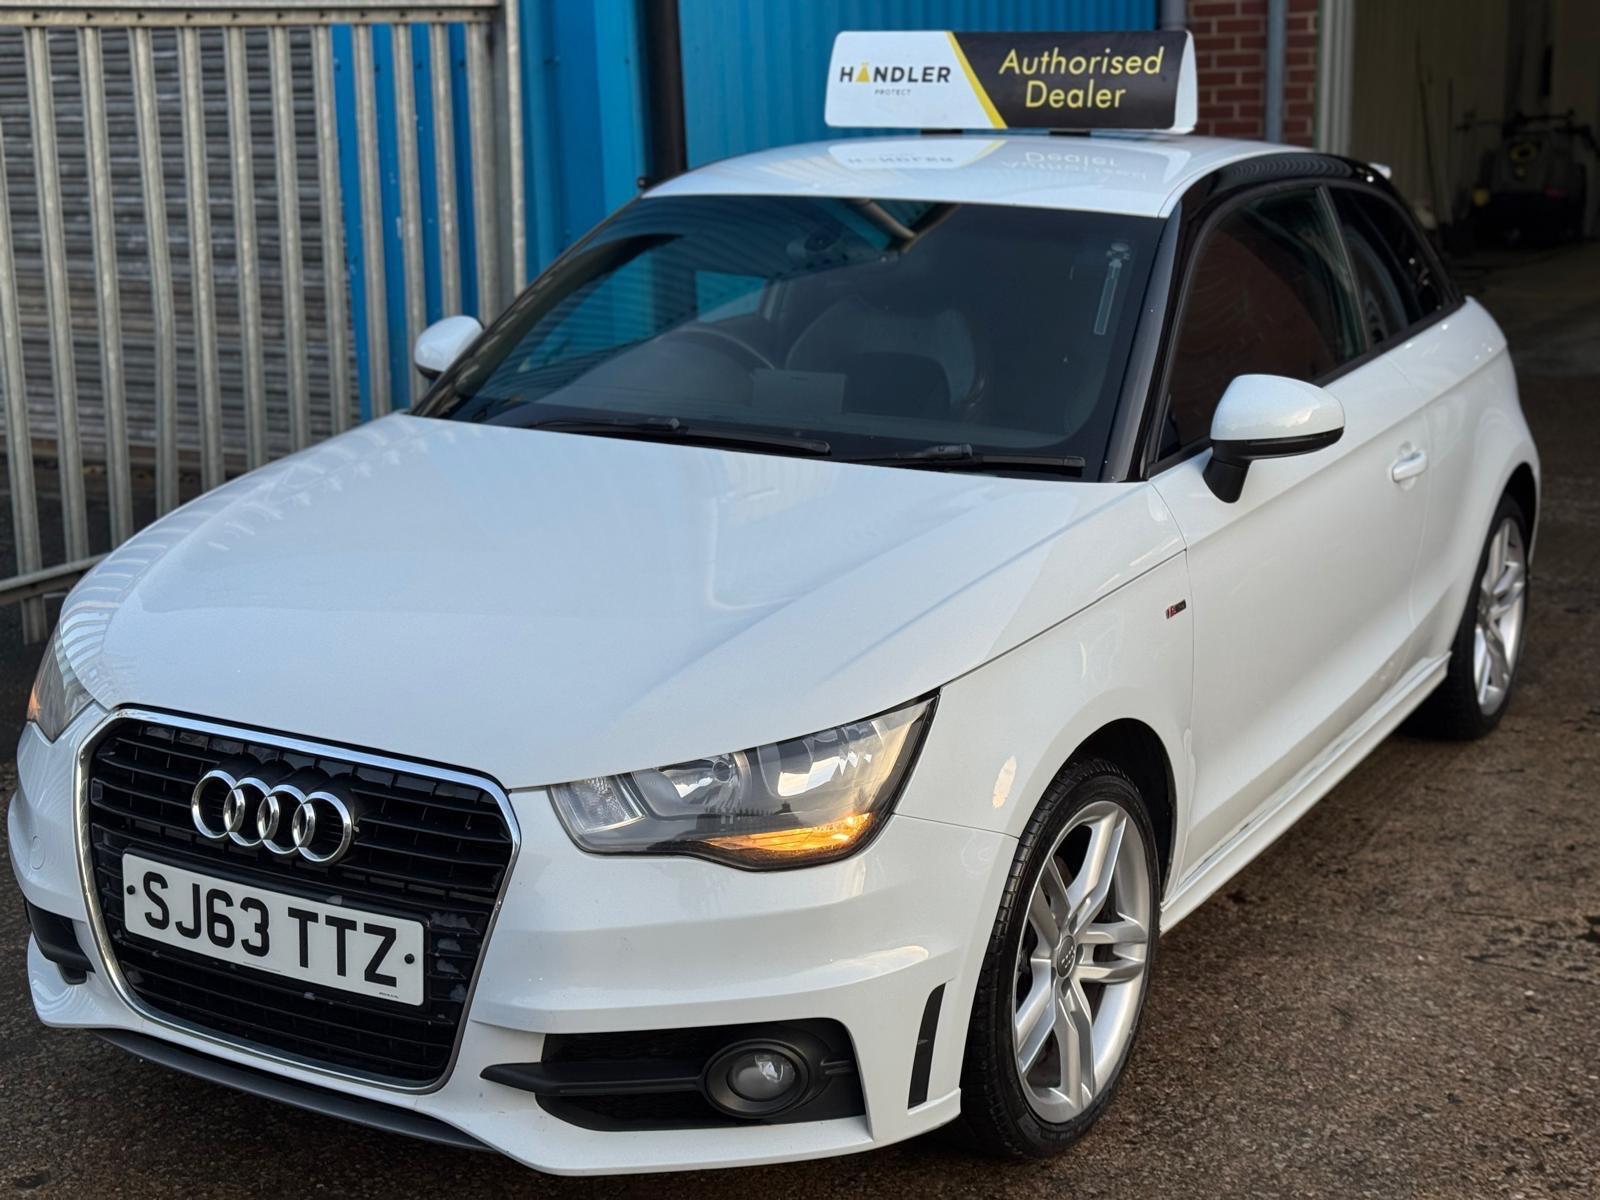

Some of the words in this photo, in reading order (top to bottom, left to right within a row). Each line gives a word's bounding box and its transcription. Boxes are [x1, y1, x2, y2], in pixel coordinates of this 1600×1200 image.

[998, 46, 1165, 76] Authorised
[875, 88, 912, 96] PROTECT
[1025, 79, 1127, 109] Dealer
[142, 871, 270, 957] SJ63
[287, 907, 397, 988] TTZ
